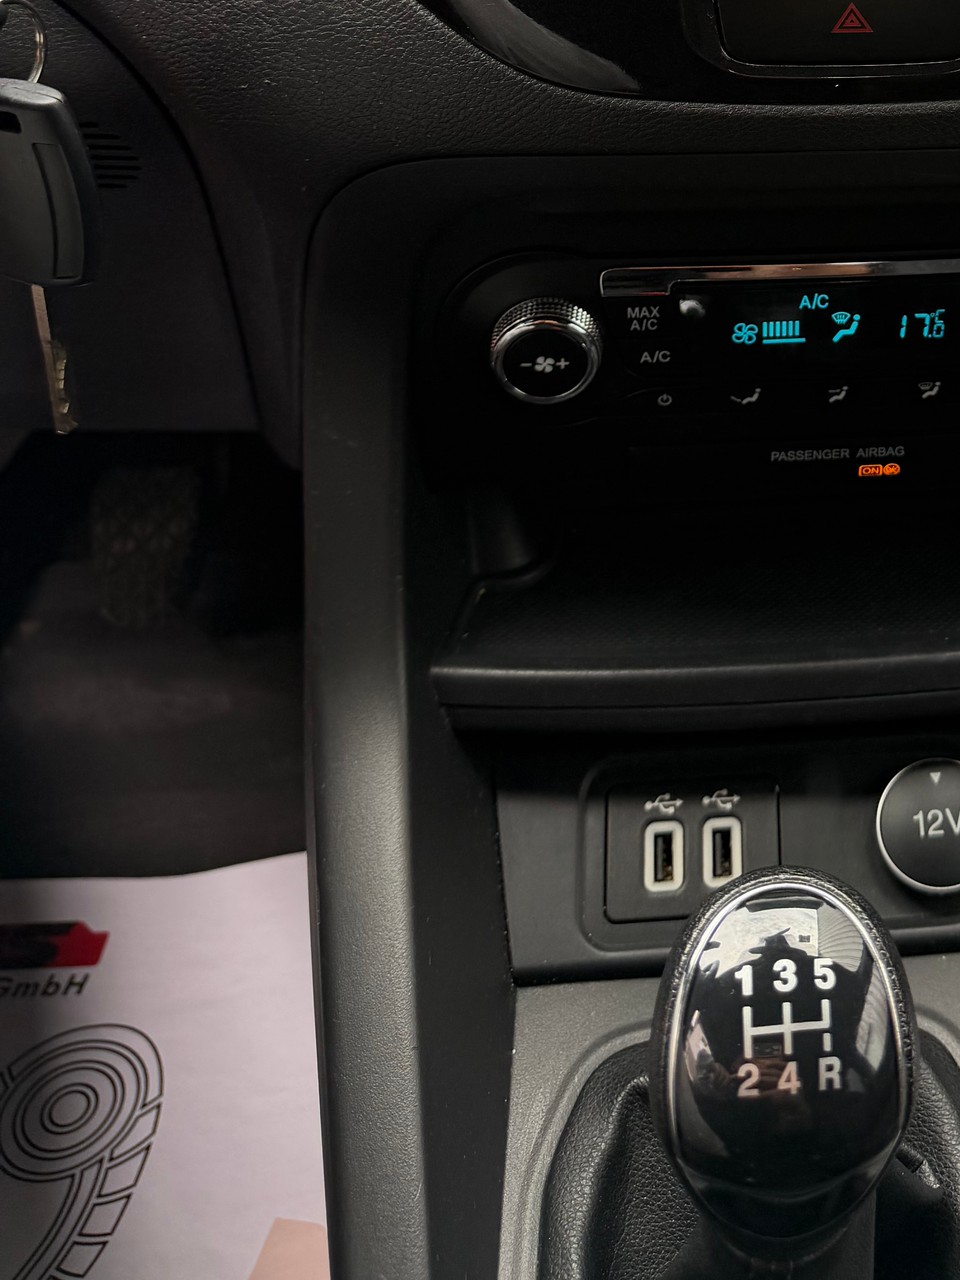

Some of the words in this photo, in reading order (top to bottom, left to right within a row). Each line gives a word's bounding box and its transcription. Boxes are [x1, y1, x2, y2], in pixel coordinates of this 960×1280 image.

[799, 293, 829, 309] A/C
[627, 306, 660, 319] MAX
[630, 318, 658, 331] A/C
[640, 350, 671, 363] A/C
[770, 448, 850, 462] PASSENGER
[855, 445, 905, 458] AIRBAG
[862, 466, 879, 474] ON
[734, 965, 754, 996] 1
[772, 959, 797, 992] 3
[813, 959, 836, 990] 5
[737, 1063, 761, 1098] 2
[777, 1061, 801, 1096] 4
[818, 1056, 842, 1091] R
